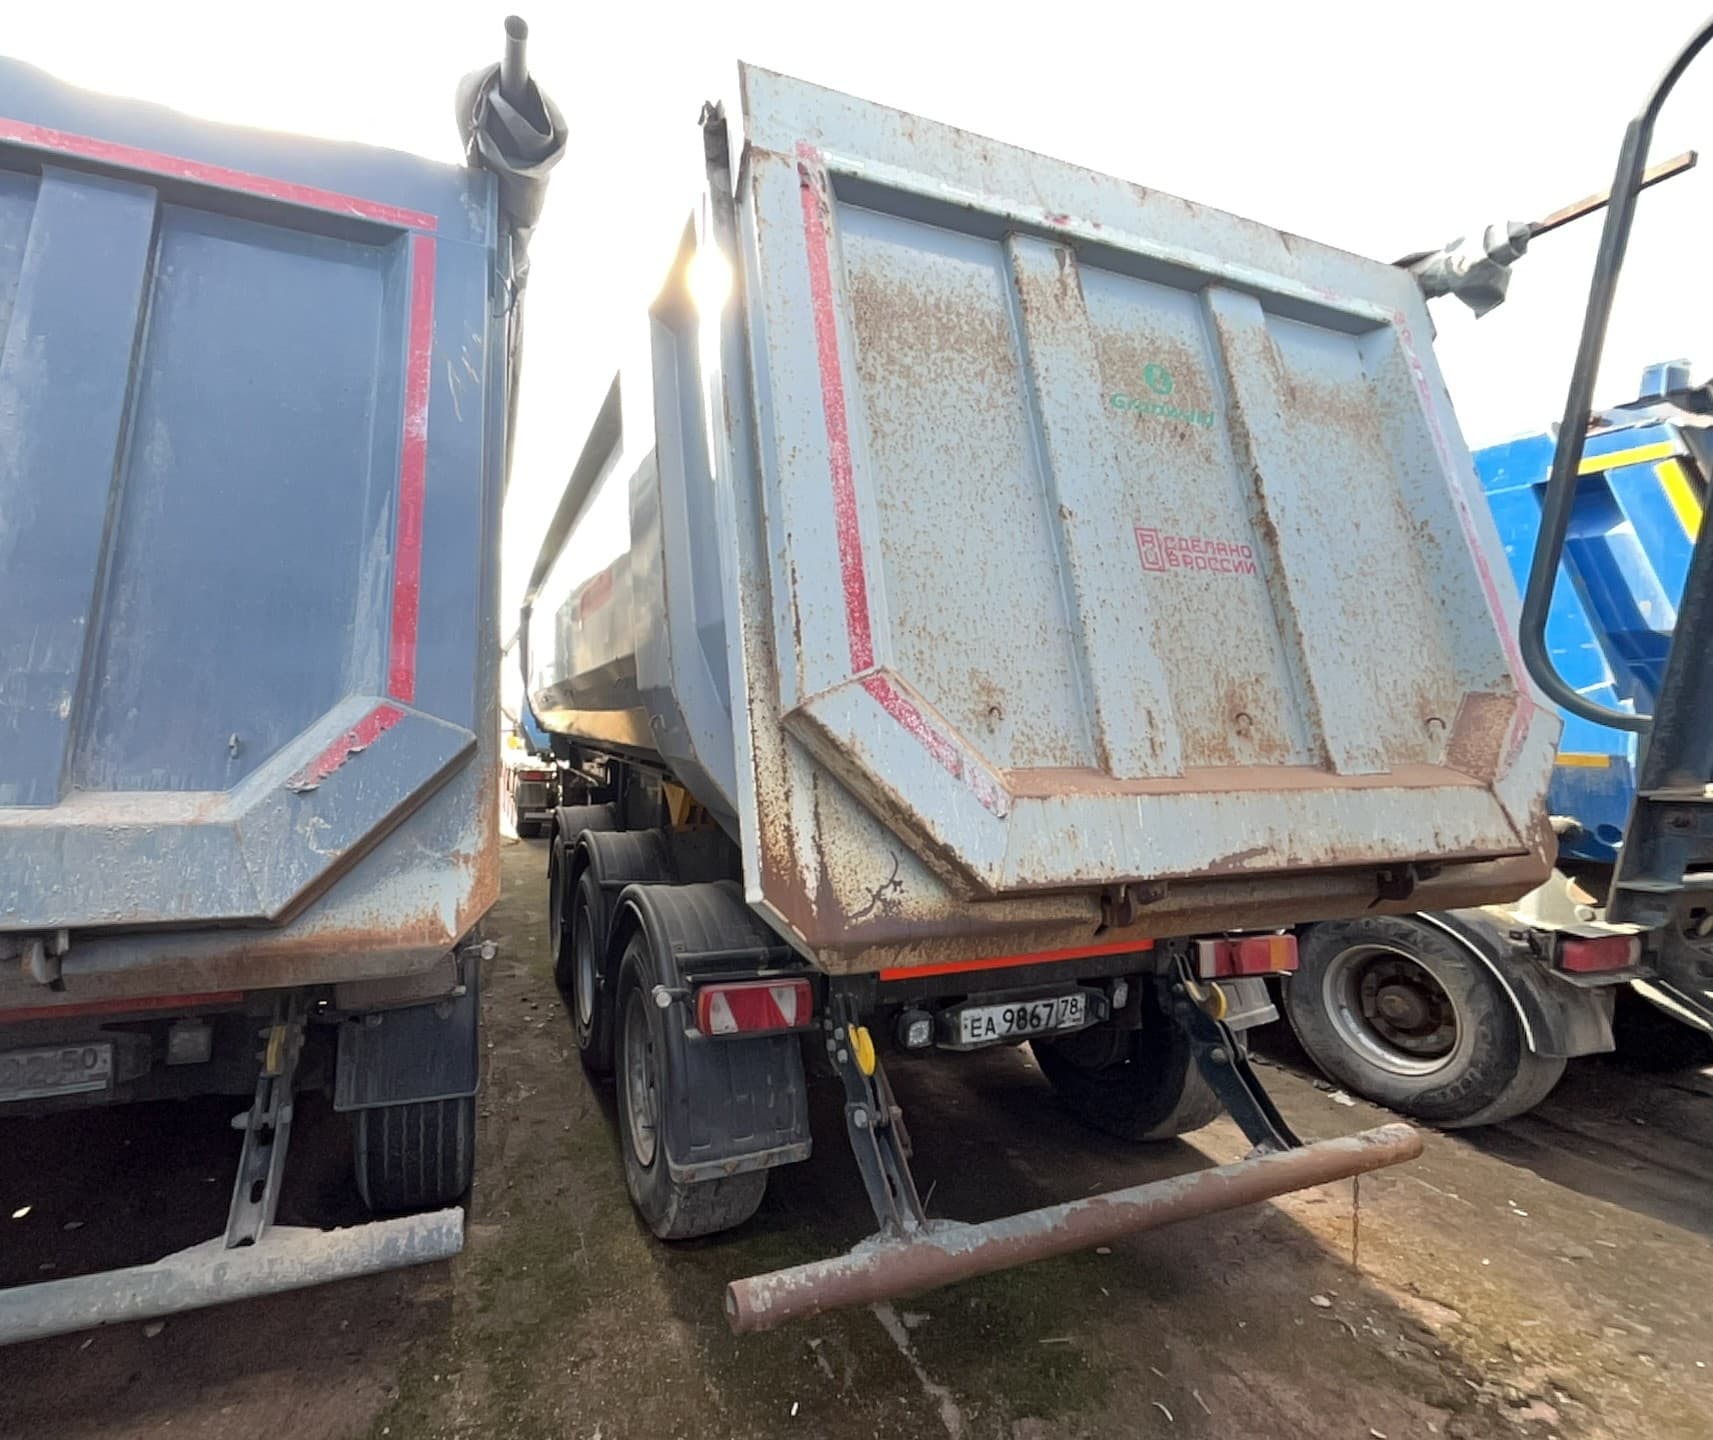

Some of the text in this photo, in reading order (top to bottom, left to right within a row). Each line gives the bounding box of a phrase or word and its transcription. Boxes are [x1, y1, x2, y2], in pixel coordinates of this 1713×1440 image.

[1163, 536, 1253, 559] СДЕЛАНО
[1182, 555, 1257, 575] РОССИИ
[1002, 1003, 1054, 1033] 9867
[1061, 998, 1079, 1017] 78
